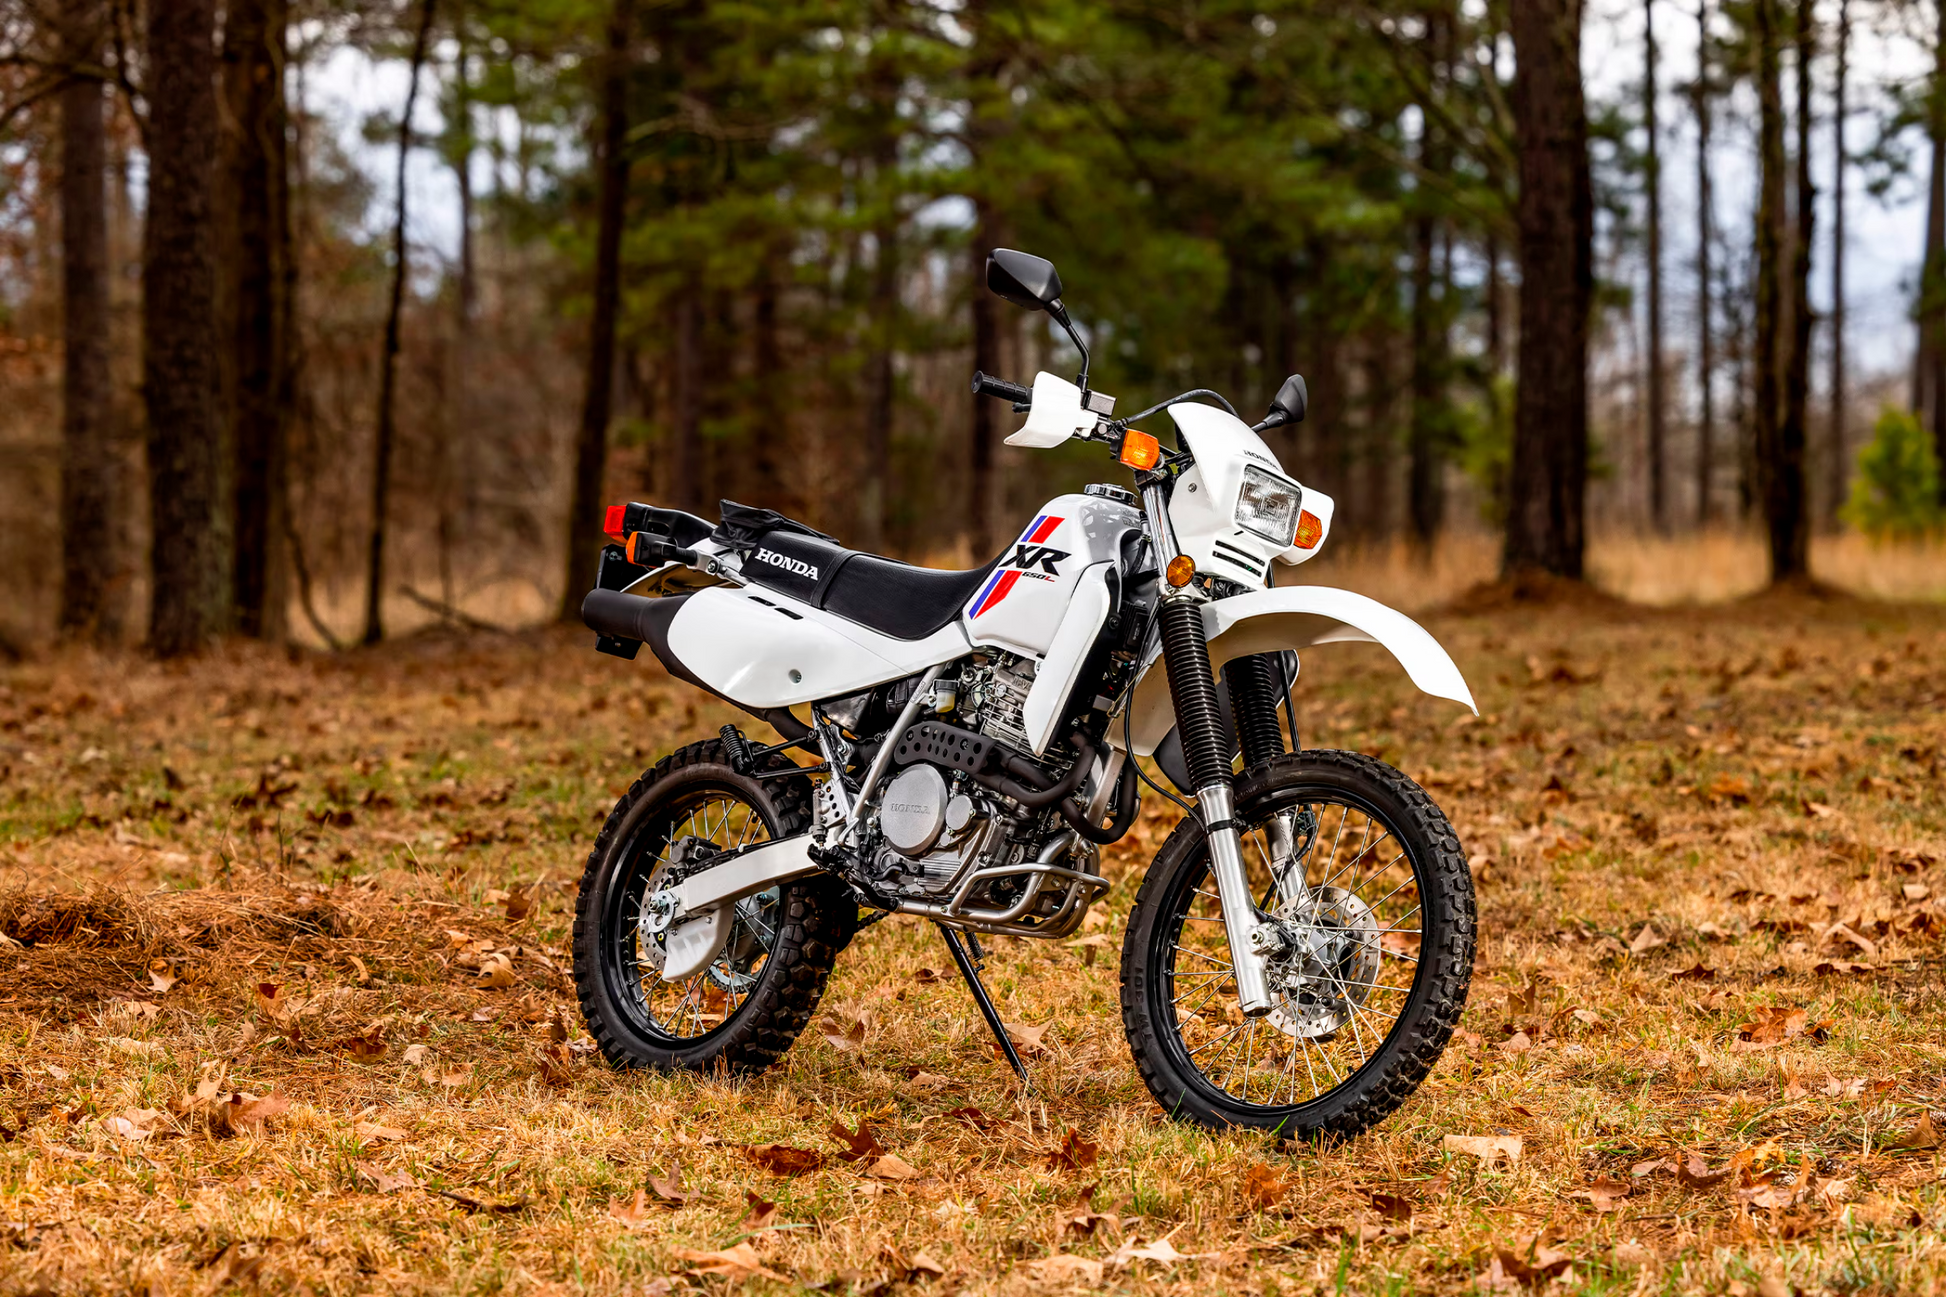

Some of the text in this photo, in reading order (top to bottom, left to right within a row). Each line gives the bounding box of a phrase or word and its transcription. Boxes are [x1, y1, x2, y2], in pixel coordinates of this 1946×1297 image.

[755, 547, 819, 581] HONDA
[998, 544, 1072, 577] XR
[1022, 571, 1055, 583] 650L
[890, 803, 931, 815] HONDA
